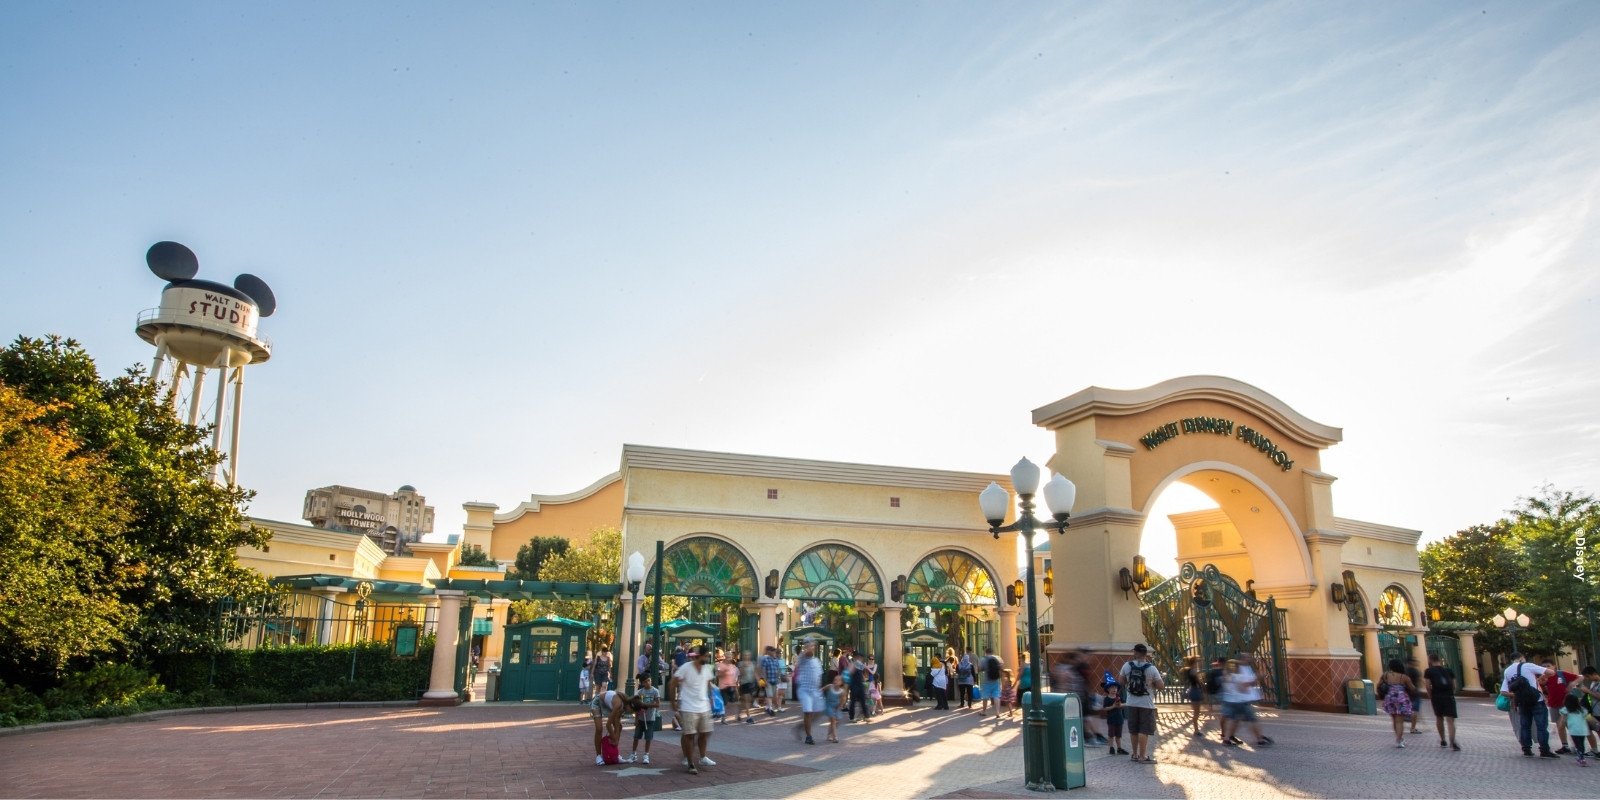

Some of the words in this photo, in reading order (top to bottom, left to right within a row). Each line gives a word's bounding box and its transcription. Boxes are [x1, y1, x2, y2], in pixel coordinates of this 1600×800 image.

[204, 293, 230, 305] WALT
[1139, 421, 1180, 451] WALT
[1180, 415, 1233, 436] DISNEY
[1236, 424, 1294, 472] STUDIOS
[341, 509, 385, 522] HOLLYWOOD
[350, 518, 375, 528] TOWER
